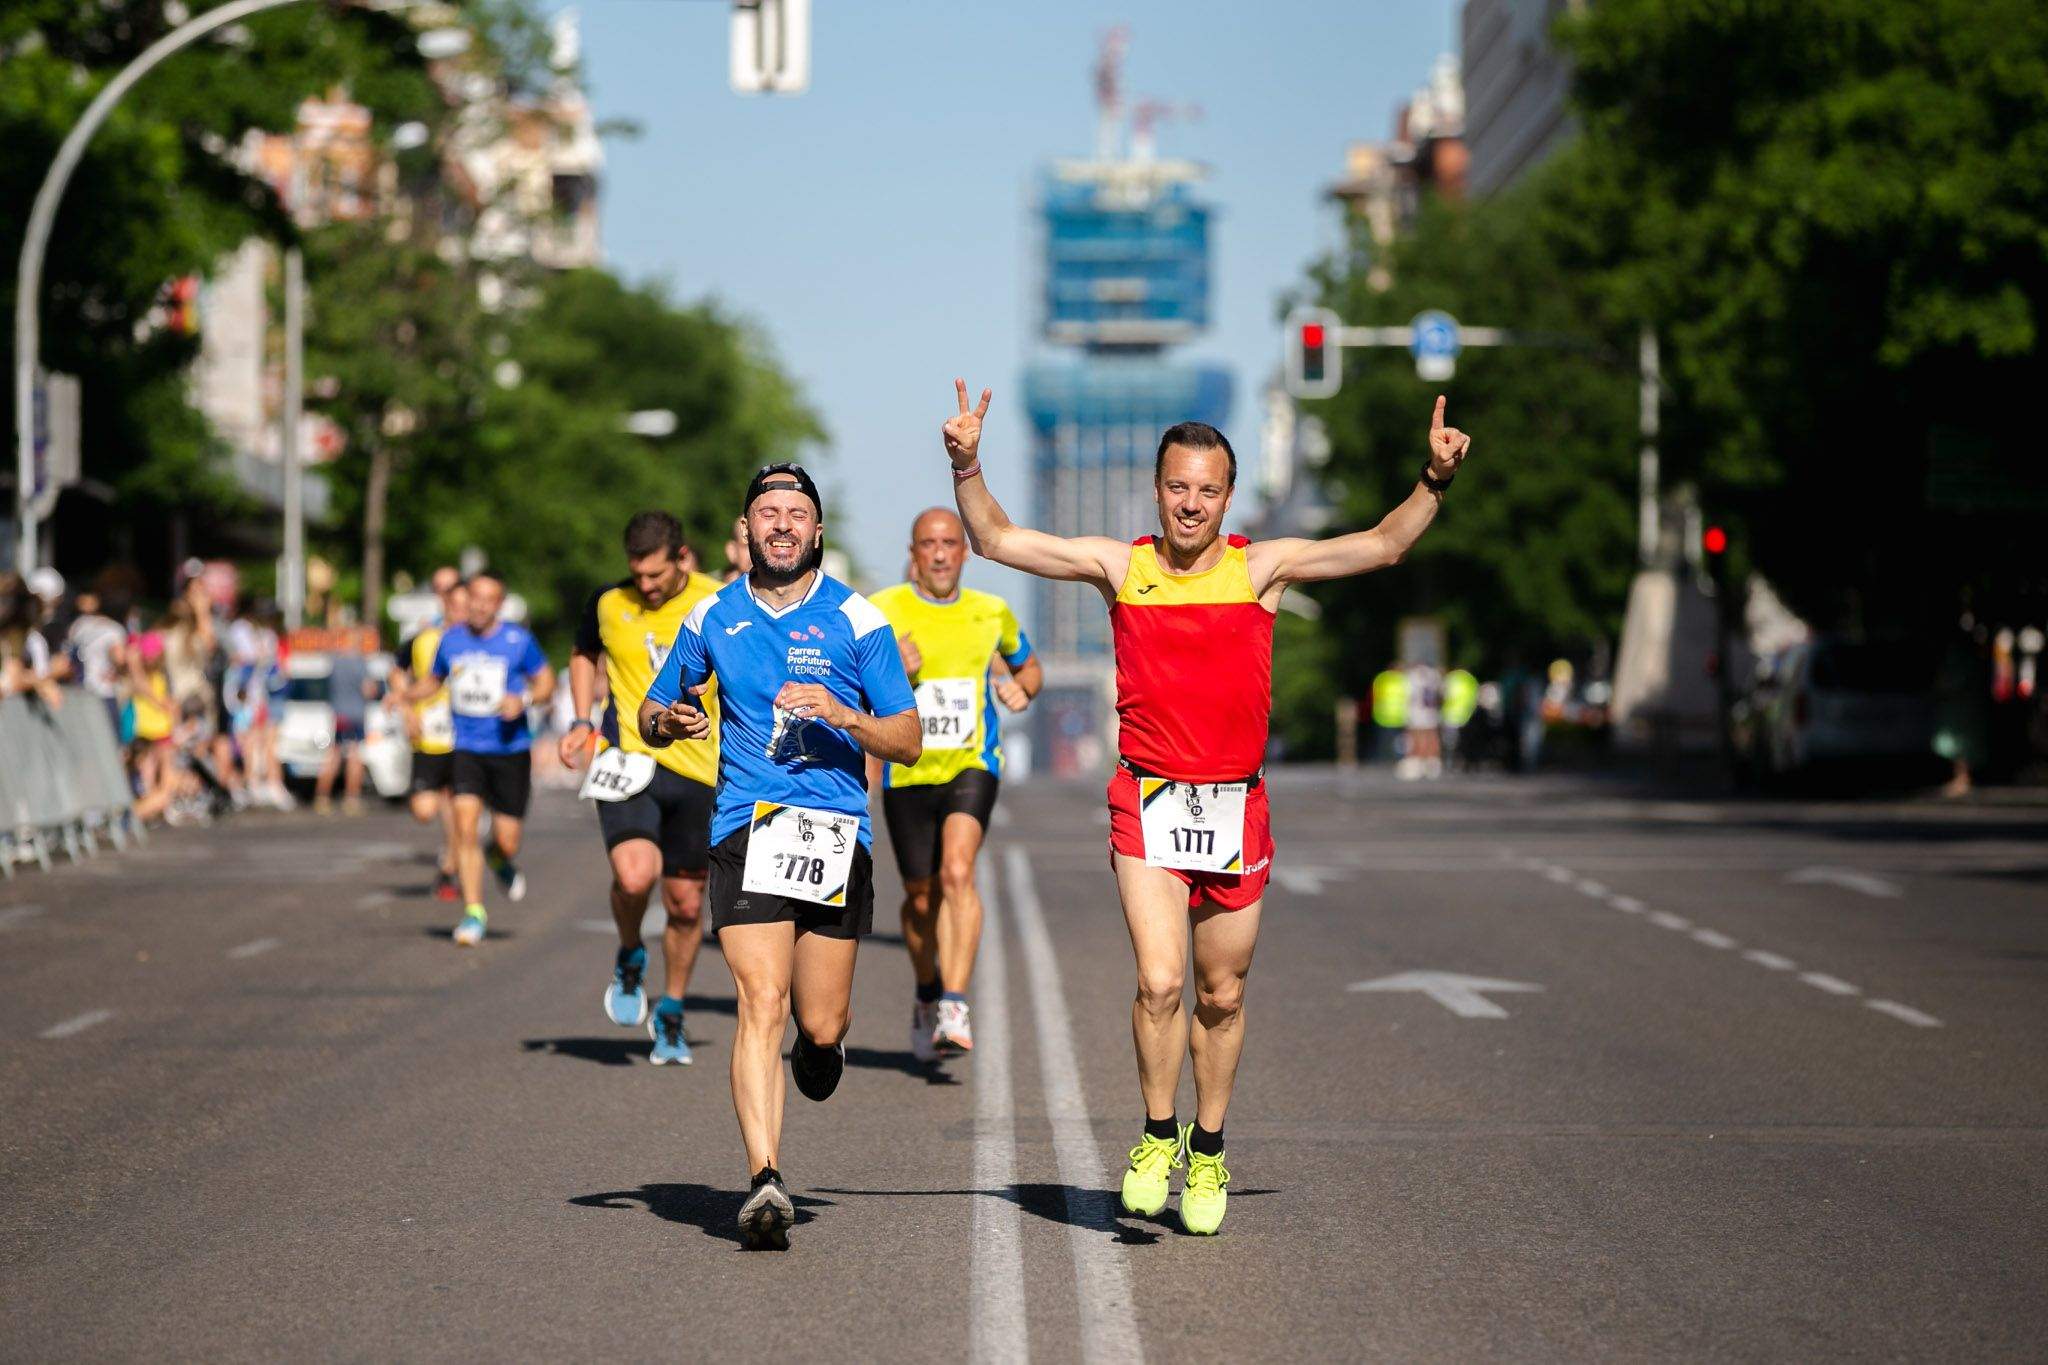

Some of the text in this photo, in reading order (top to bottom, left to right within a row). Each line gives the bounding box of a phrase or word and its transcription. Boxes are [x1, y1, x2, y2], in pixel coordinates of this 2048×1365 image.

[788, 646, 821, 656] Carrera
[787, 655, 831, 667] ProFuturo
[787, 665, 830, 676] V EDICIÓN
[1169, 827, 1215, 855] 1777
